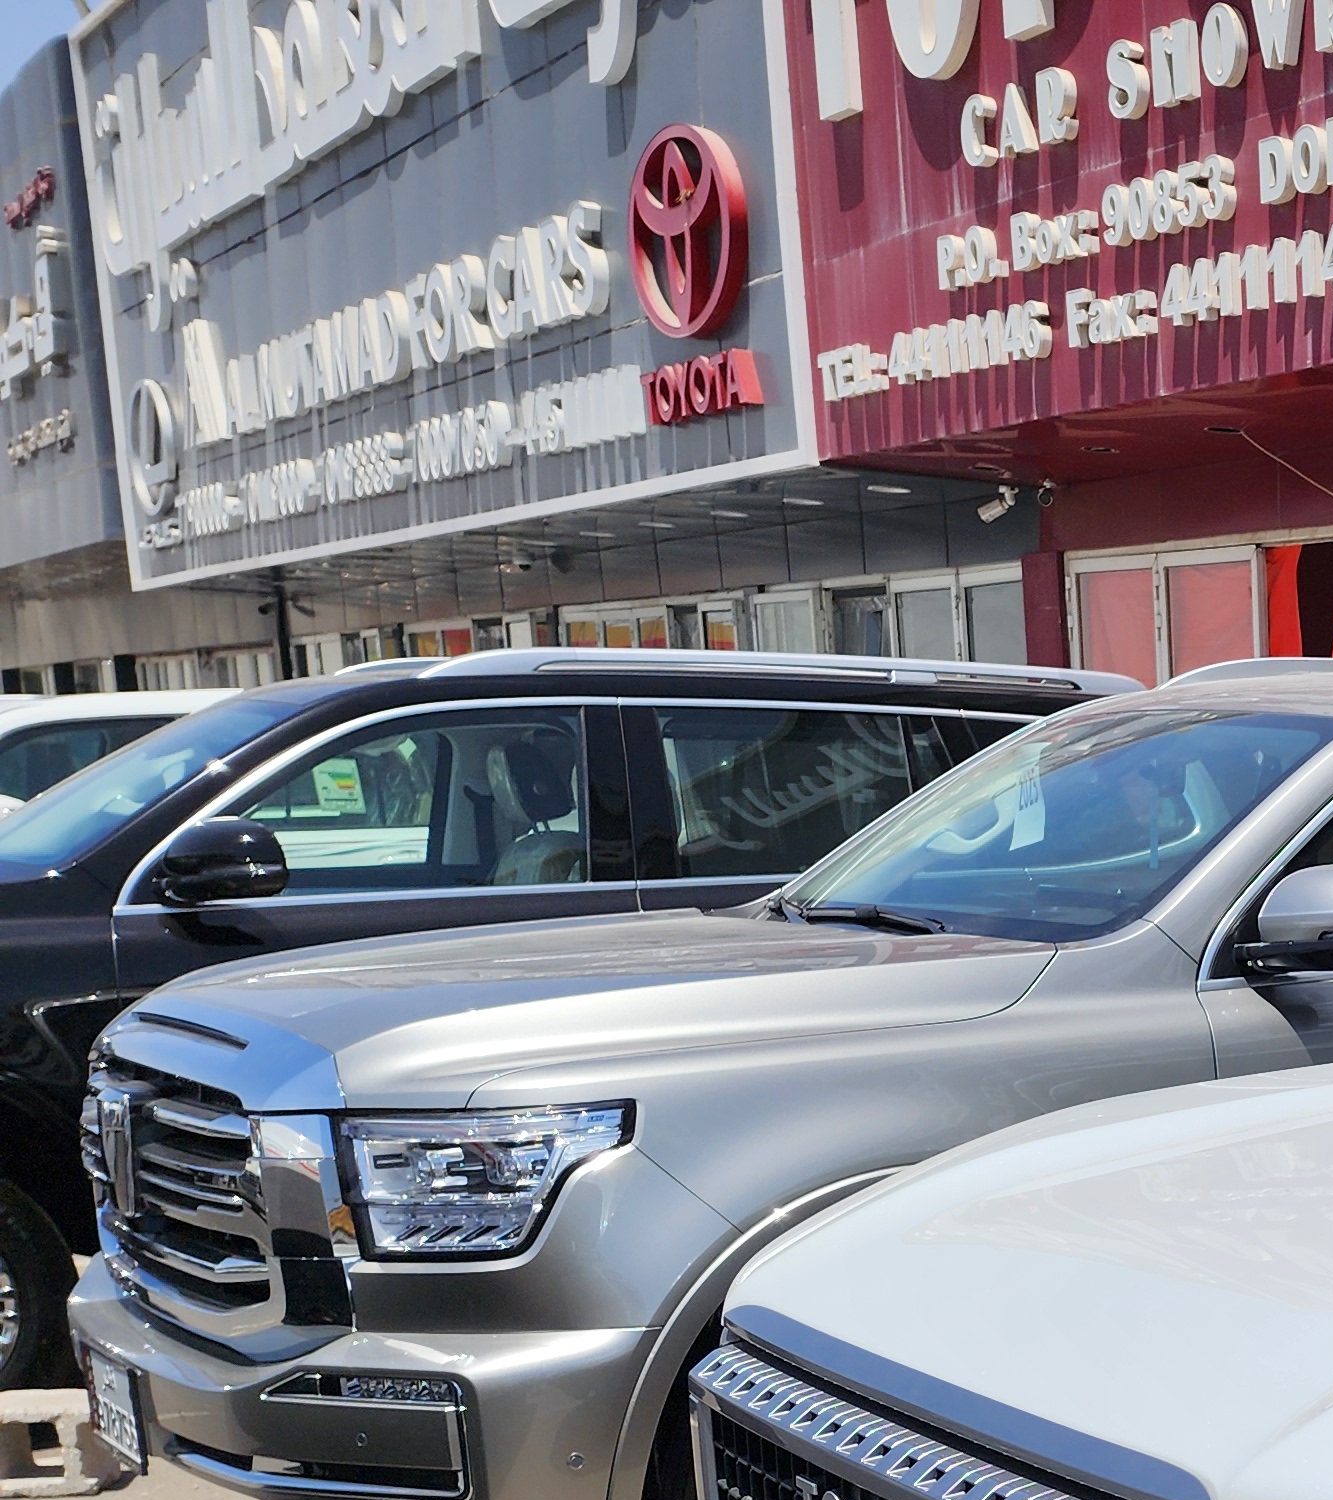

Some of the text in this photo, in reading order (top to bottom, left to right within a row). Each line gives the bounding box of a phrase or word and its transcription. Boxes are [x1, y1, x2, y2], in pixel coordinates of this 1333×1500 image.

[961, 66, 1079, 168] CAR
[936, 225, 1010, 291] P.O.
[1102, 154, 1237, 247] 90853
[405, 253, 495, 370] FOR
[486, 200, 609, 340] CARS
[641, 347, 765, 427] TOYOTA
